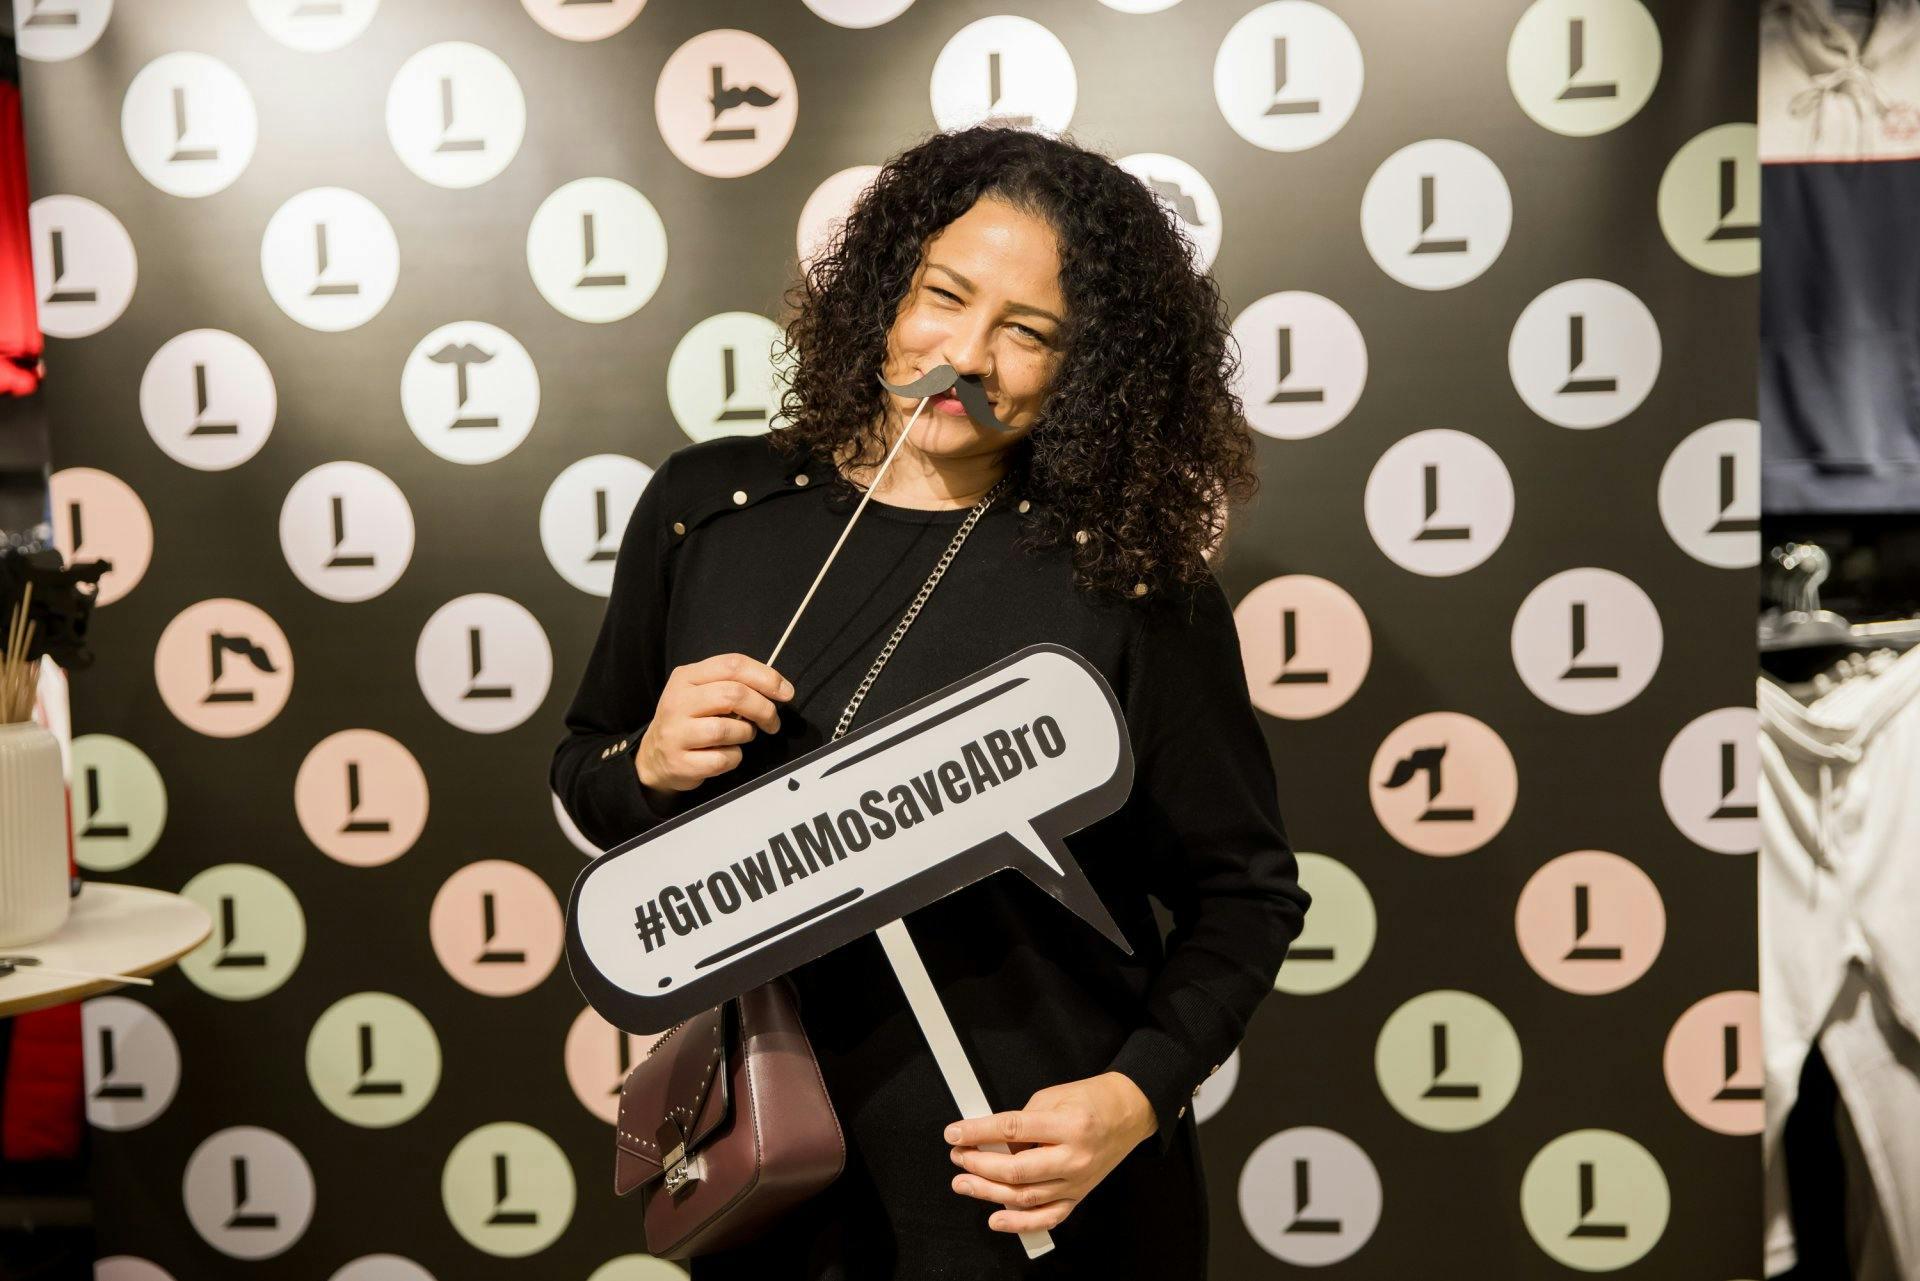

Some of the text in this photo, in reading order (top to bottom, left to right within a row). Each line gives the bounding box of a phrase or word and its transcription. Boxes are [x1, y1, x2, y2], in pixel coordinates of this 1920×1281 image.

[982, 53, 1033, 128] L
[1263, 36, 1320, 115] L
[1555, 19, 1617, 101] L
[168, 87, 219, 162] L
[435, 77, 486, 151] L
[1409, 175, 1468, 255] L
[1704, 159, 1760, 241] L
[45, 231, 96, 302] L
[309, 223, 359, 296] L
[575, 213, 626, 287] L
[715, 348, 765, 421] L
[1266, 327, 1323, 403] L
[1556, 315, 1617, 394] L
[186, 364, 238, 436] L
[324, 495, 375, 567] L
[1411, 465, 1470, 541] L
[1705, 454, 1760, 534] L
[460, 626, 513, 698] L
[1271, 610, 1328, 685] L
[1558, 603, 1619, 679] L
[79, 765, 130, 837] L
[338, 762, 390, 832] L
[1707, 743, 1759, 820] L
[634, 714, 1068, 953] #GrowAMoSaveABro
[212, 895, 266, 967] L
[473, 893, 525, 964] L
[1562, 884, 1622, 960] L
[90, 1026, 144, 1099] L
[347, 1023, 403, 1096] L
[1420, 1023, 1479, 1098] L
[1709, 1025, 1765, 1101] L
[224, 1155, 278, 1228] L
[483, 1153, 538, 1224] L
[1283, 1159, 1340, 1234] L
[1567, 1163, 1627, 1238] L
